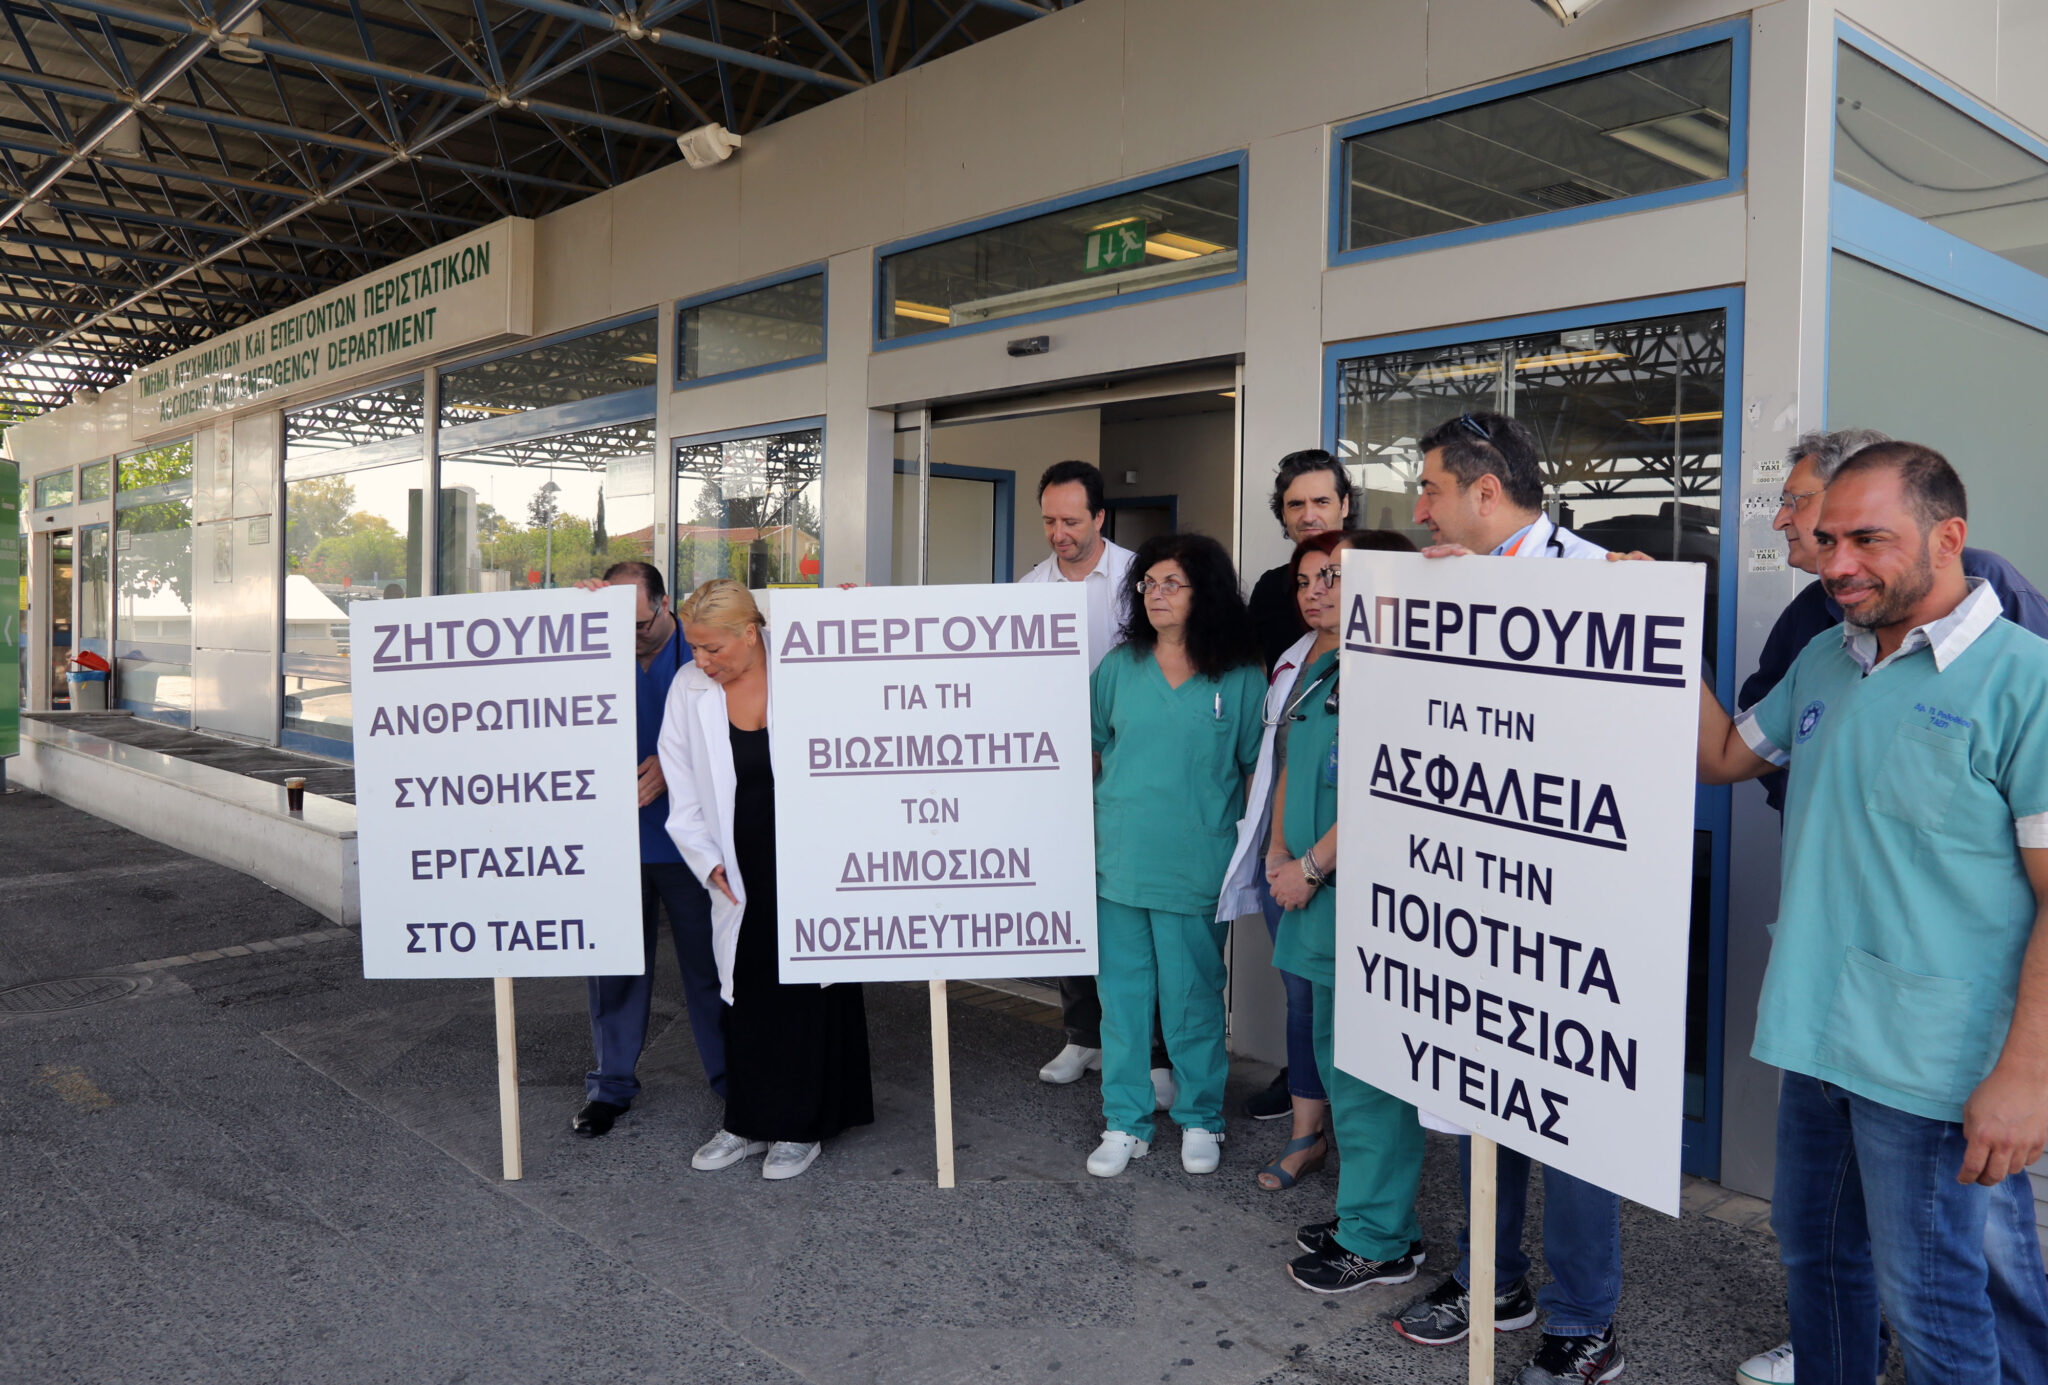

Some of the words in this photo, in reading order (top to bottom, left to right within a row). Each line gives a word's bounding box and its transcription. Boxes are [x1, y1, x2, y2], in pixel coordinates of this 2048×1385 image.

[174, 341, 242, 387] ΑΤΥΧΗΜΑΤΩΝ
[244, 331, 266, 361] ΚΑΙ
[270, 293, 356, 351] ΕΠΕΙΓΟΝΤΩΝ
[364, 241, 490, 318] ΠΕΡΙΣΤΑΤΙΚΩΝ
[159, 386, 214, 423] ACCIDENT
[240, 347, 320, 399] EMERGENCY
[328, 307, 437, 371] DEPARTMENT
[373, 612, 610, 665] ΖΗΤΟΥΜΕ
[780, 613, 1079, 657] ΑΠΕΡΓΟΥΜΕ
[1346, 594, 1686, 676] ΑΠΕΡΓΟΥΜΕ
[370, 694, 618, 737] ΑΝΘΡΩΠΙΝΕΣ
[883, 684, 928, 711] ΓΙΑ
[934, 683, 972, 709] ΤΗ
[1428, 699, 1469, 732] ΓΙΑ
[1476, 706, 1535, 743] ΤΗΝ
[808, 732, 1059, 770] ΒΙΩΣΙΜΩΤΗΤΑ
[394, 769, 597, 809] ΣΥΝΘΗΚΕΣ
[900, 798, 960, 824] ΤΩΝ
[1369, 744, 1627, 841] ΑΣΦΑΛΕΙΑ
[411, 844, 586, 881] ΕΡΓΑΣΙΑΣ
[840, 847, 1031, 884] ΔΗΜΟΣΙΩΝ
[1409, 834, 1463, 883] ΚΑΙ
[1475, 850, 1553, 906] ΤΗΝ
[406, 922, 477, 954] ΣΤΟ
[487, 919, 597, 952] ΤΑΕΠ.
[795, 911, 1082, 953] ΝΟΣΗΛΕΥΤΗΡΙΩΝ.
[1371, 883, 1621, 1005] ΠΟΙΟΤΗΤΑ
[1356, 946, 1638, 1092] ΥΠΗΡΕΣΙΩΝ
[1401, 1033, 1569, 1146] ΥΓΕΙΑΣ
